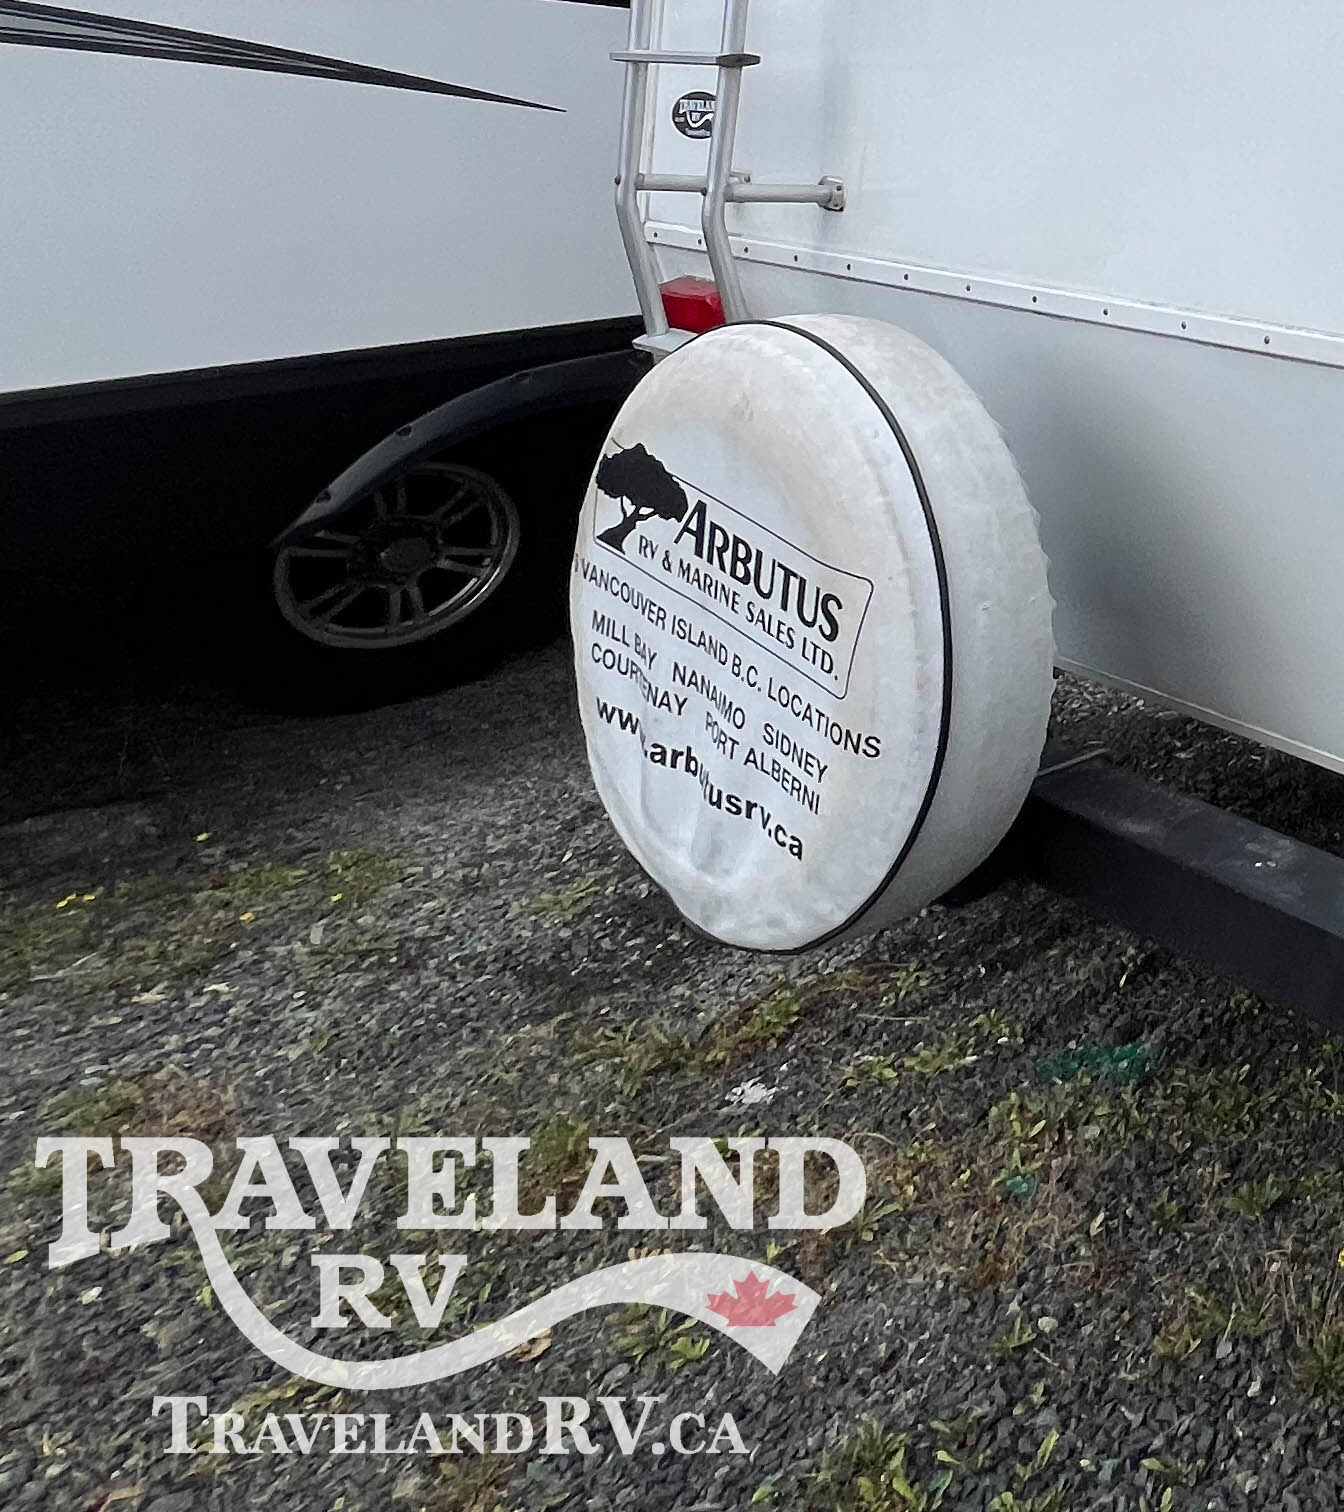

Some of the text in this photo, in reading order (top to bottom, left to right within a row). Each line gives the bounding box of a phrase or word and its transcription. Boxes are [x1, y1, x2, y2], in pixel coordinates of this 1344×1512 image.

[638, 534, 839, 681] RV & MARINE SALES LTD.
[673, 499, 843, 642] ARBUTUS
[581, 557, 881, 758] VANCOUVER ISLAND B.C. LOCATIONS
[591, 642, 820, 815] COURTENAY PORT ALBERNI
[592, 609, 829, 784] MILL BAY NANAIMO SIDNEY
